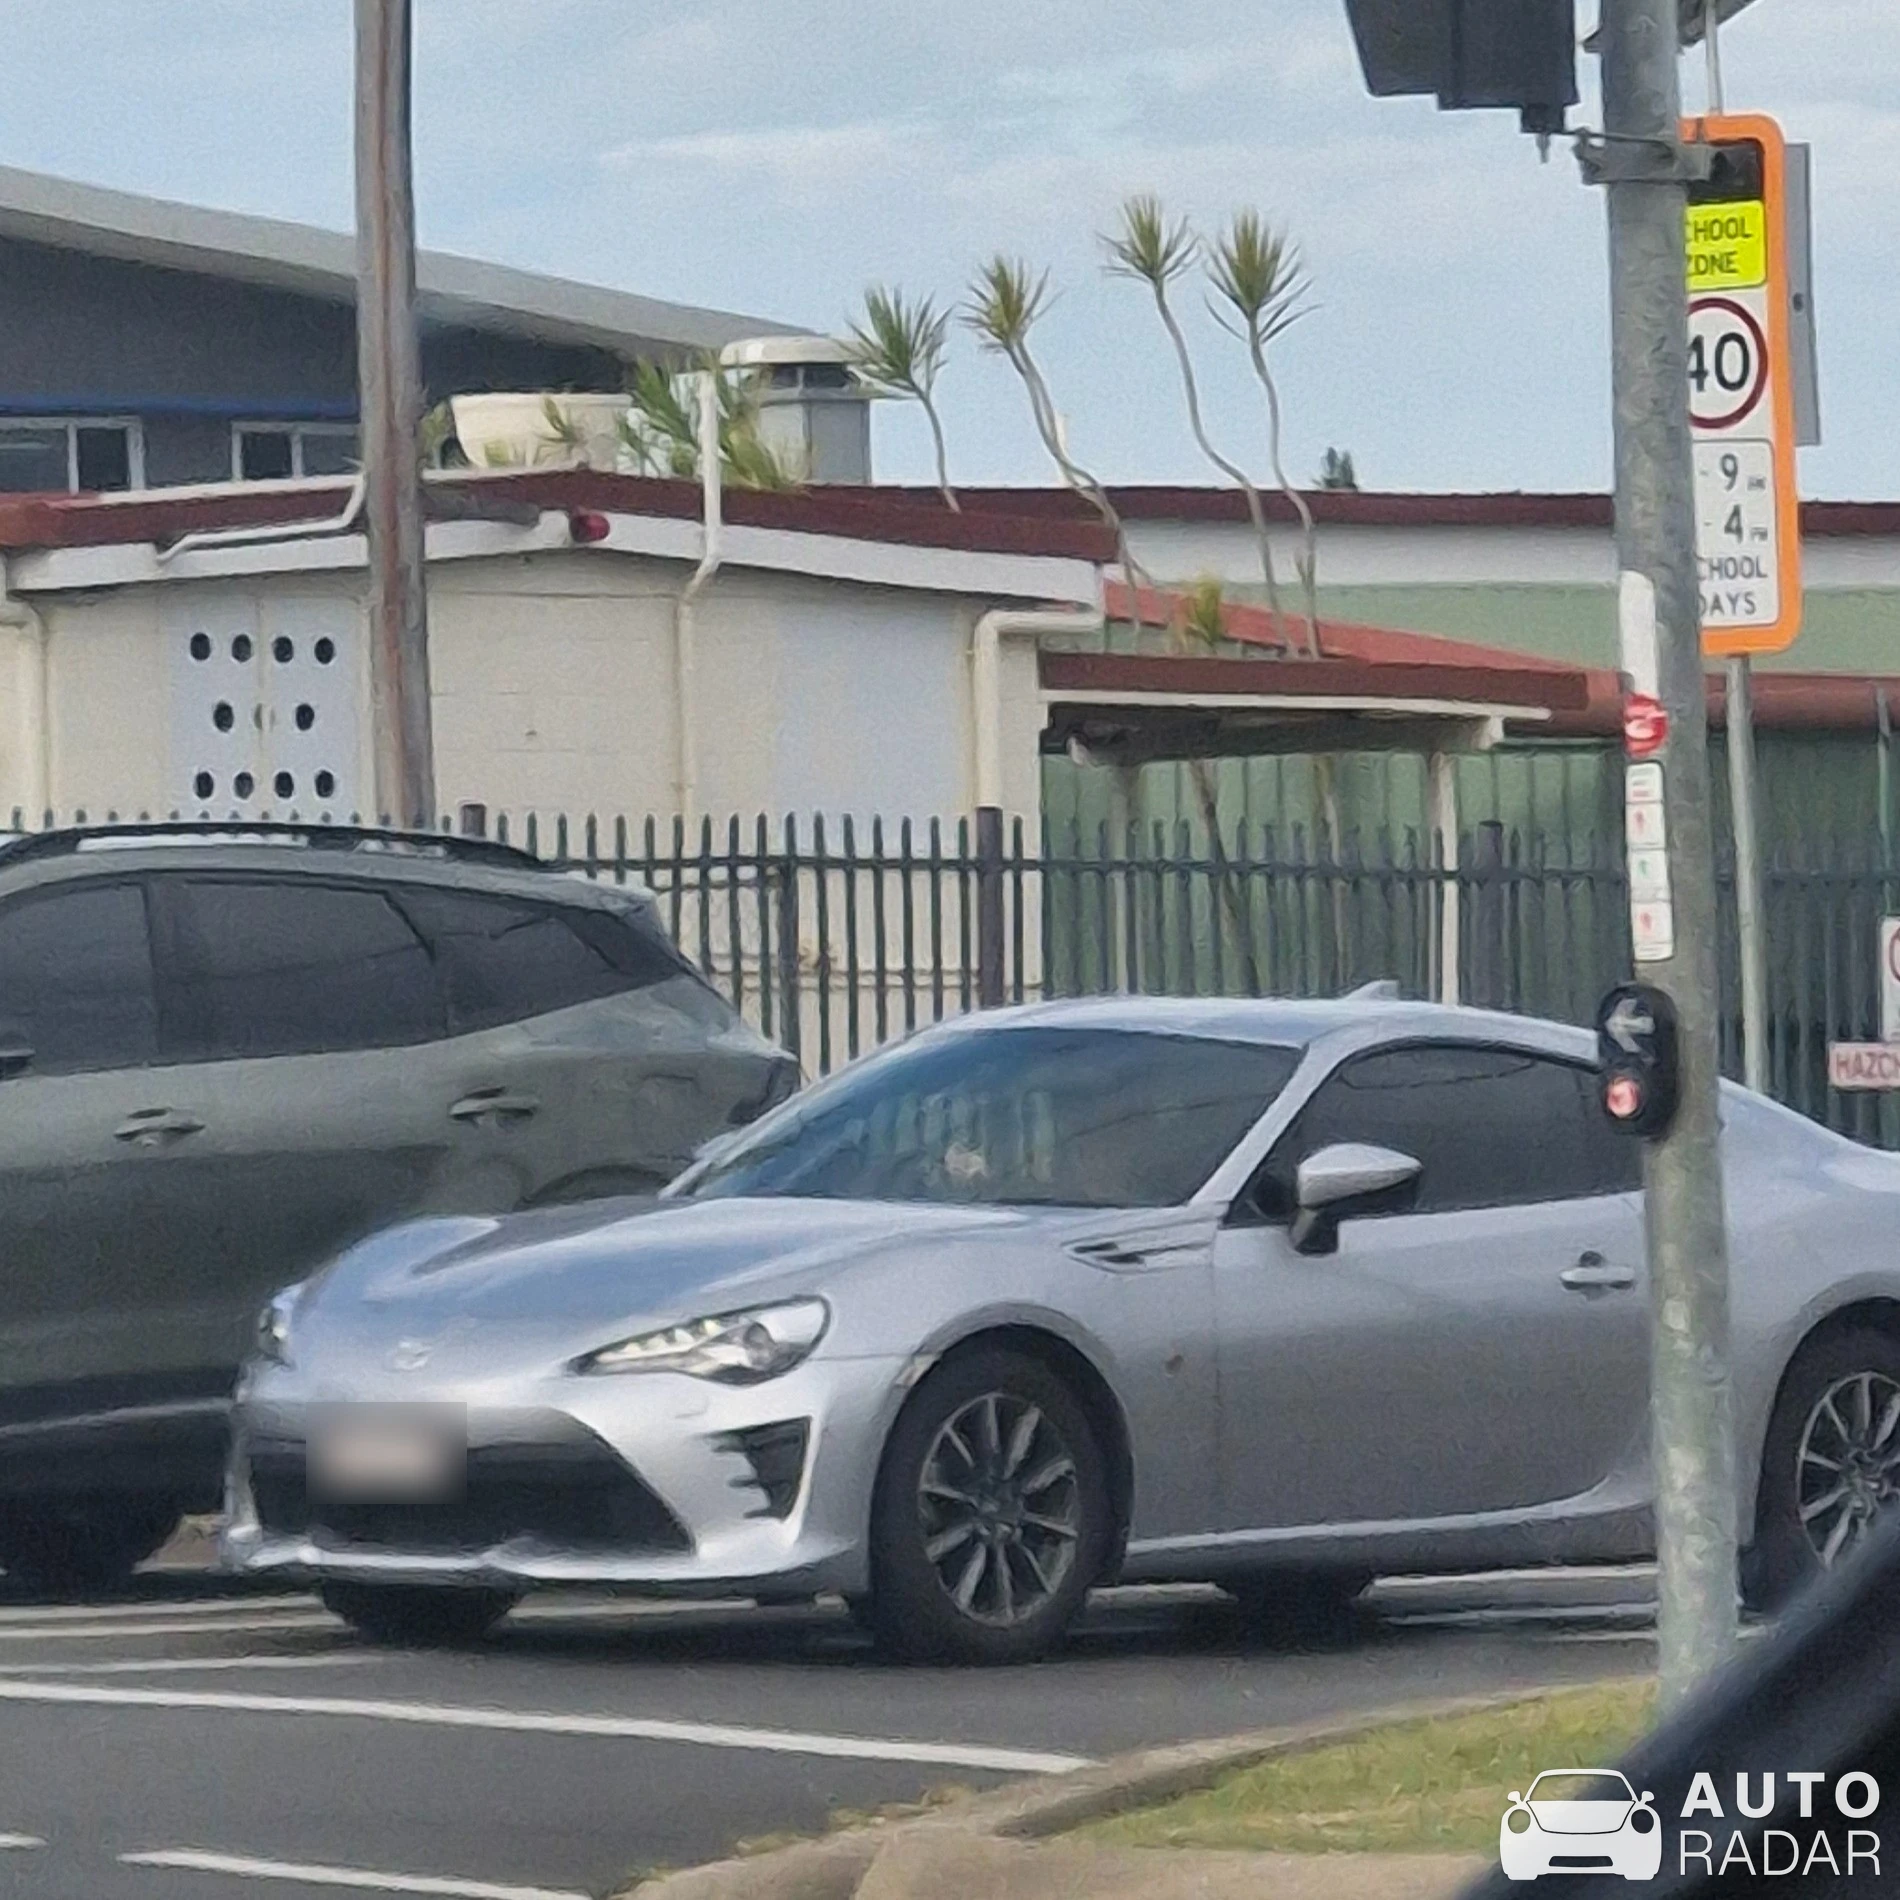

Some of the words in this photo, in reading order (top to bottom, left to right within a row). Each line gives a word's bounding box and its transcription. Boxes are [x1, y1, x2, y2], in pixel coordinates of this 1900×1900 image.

[1689, 332, 1750, 392] 40
[1720, 453, 1738, 492] 9
[1724, 503, 1744, 544] 4
